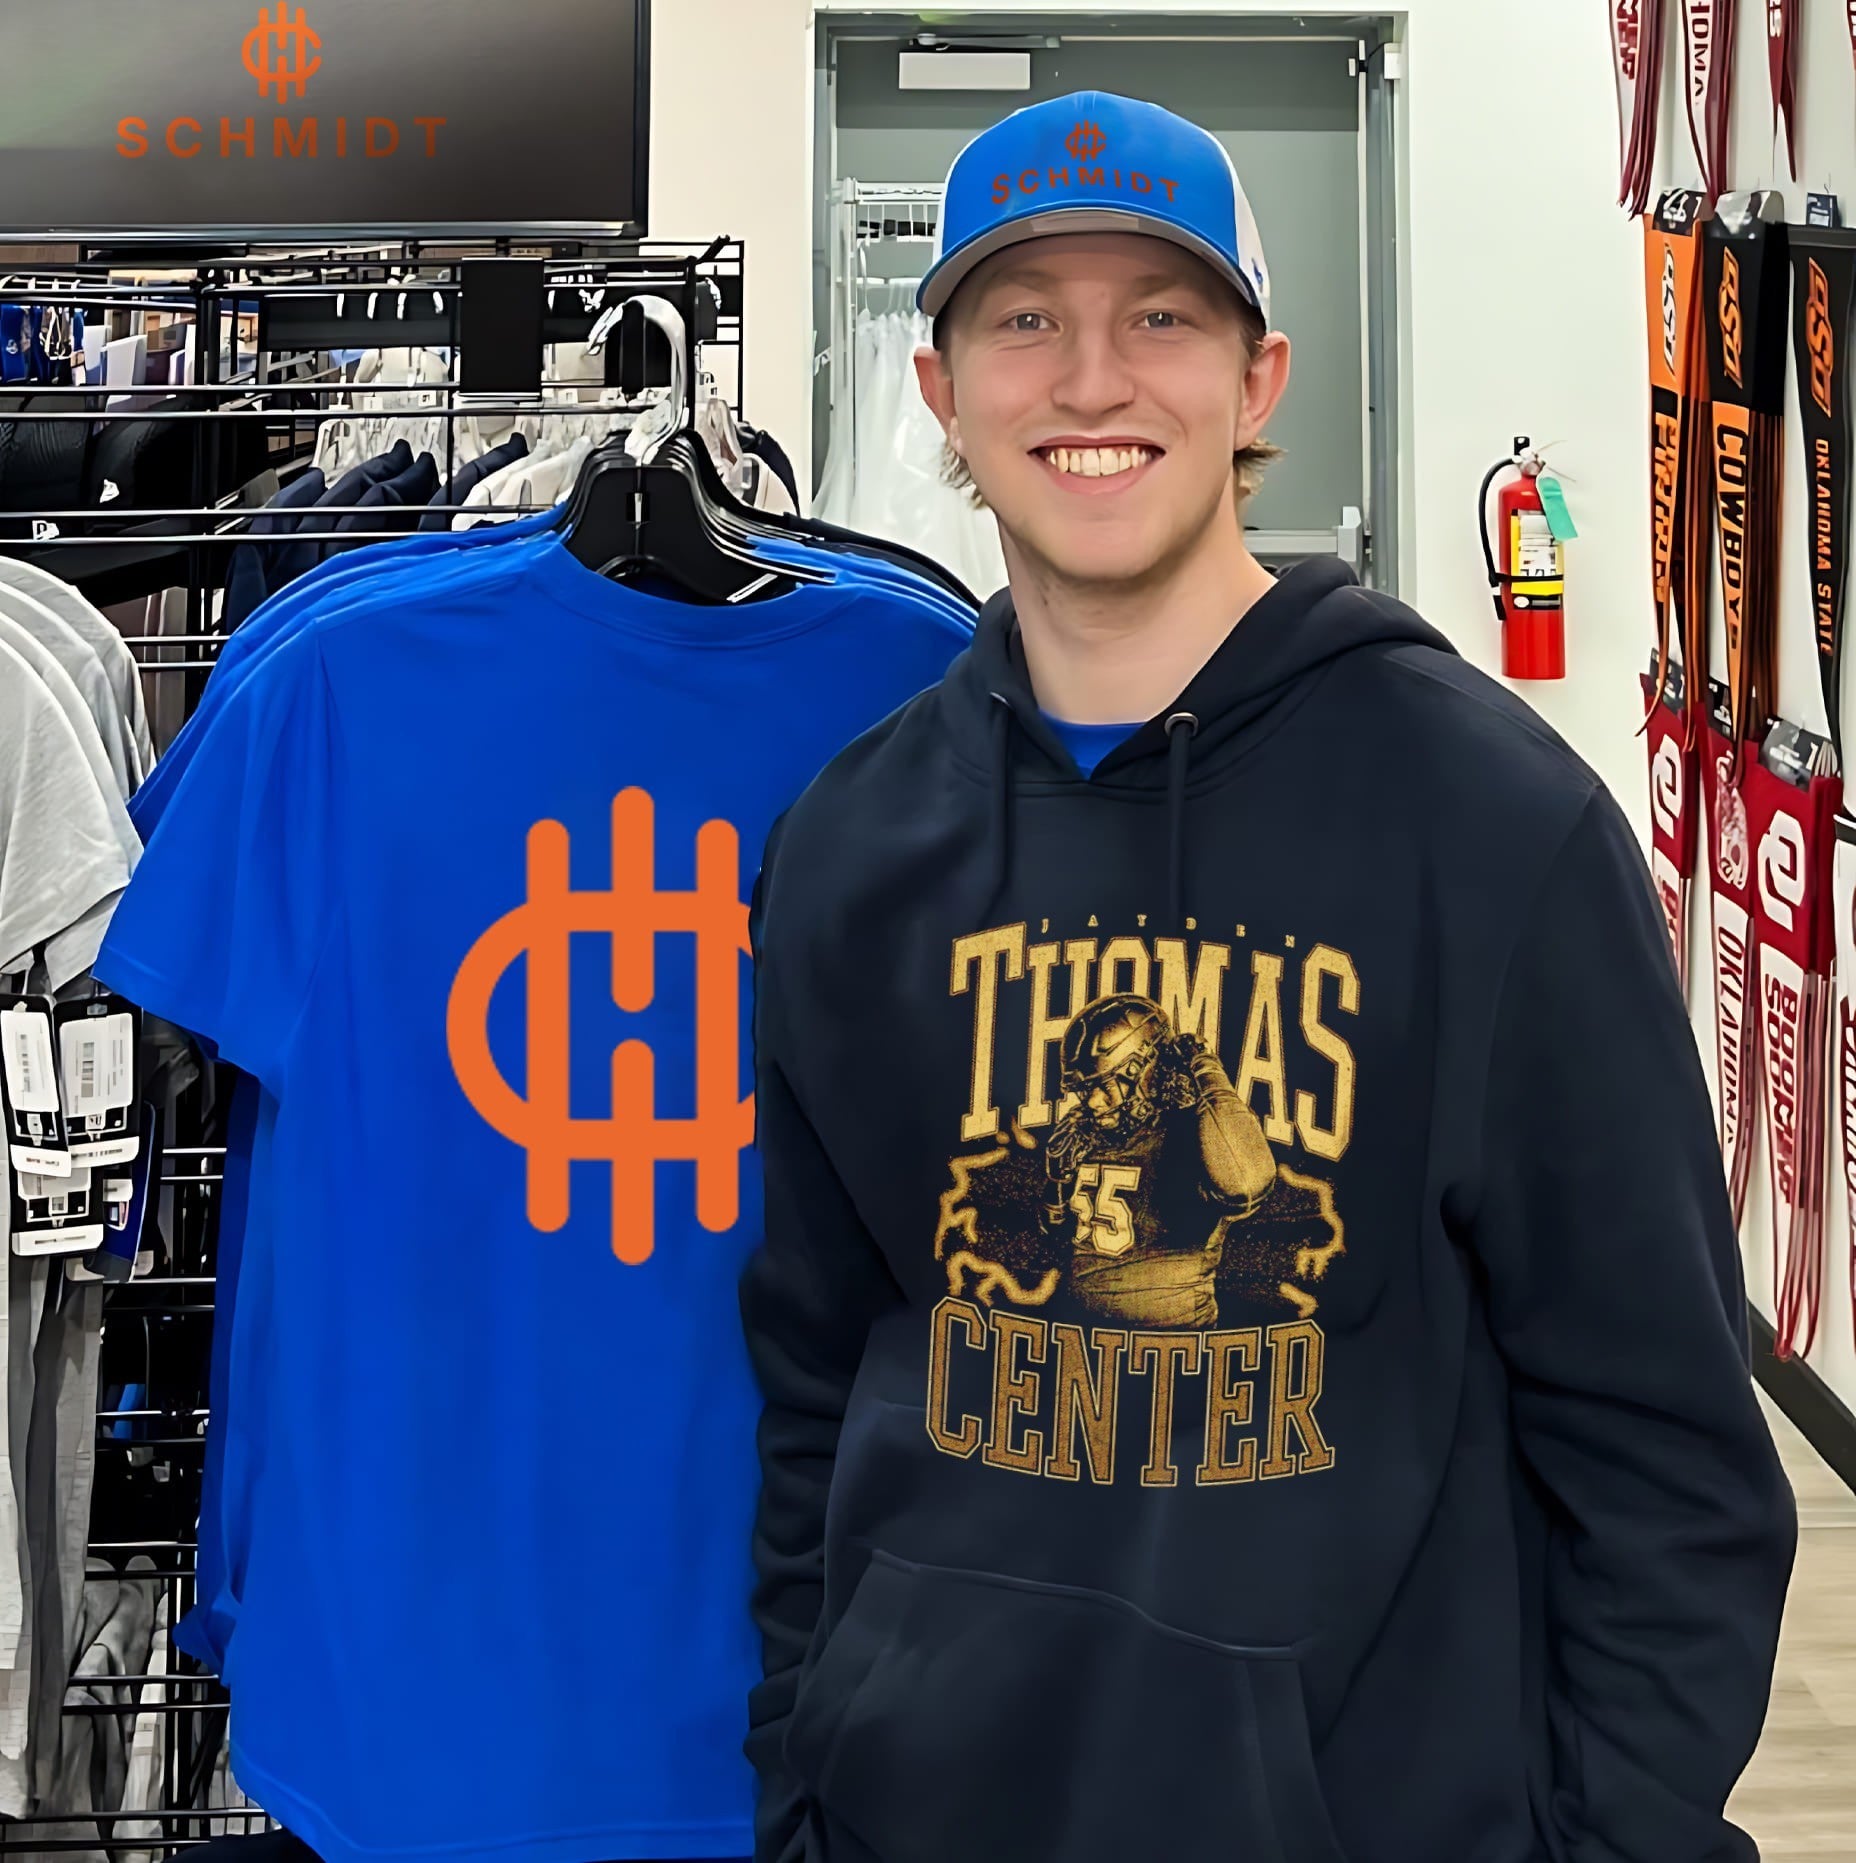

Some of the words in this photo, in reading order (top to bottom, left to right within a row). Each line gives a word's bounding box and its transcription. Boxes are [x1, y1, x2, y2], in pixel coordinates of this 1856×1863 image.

[115, 116, 448, 158] SCHMIDT
[991, 167, 1180, 205] SCHMIDT
[1040, 913, 1296, 949] JAYDEN
[1070, 1163, 1142, 1257] 55
[925, 1296, 1336, 1487] CENTER
